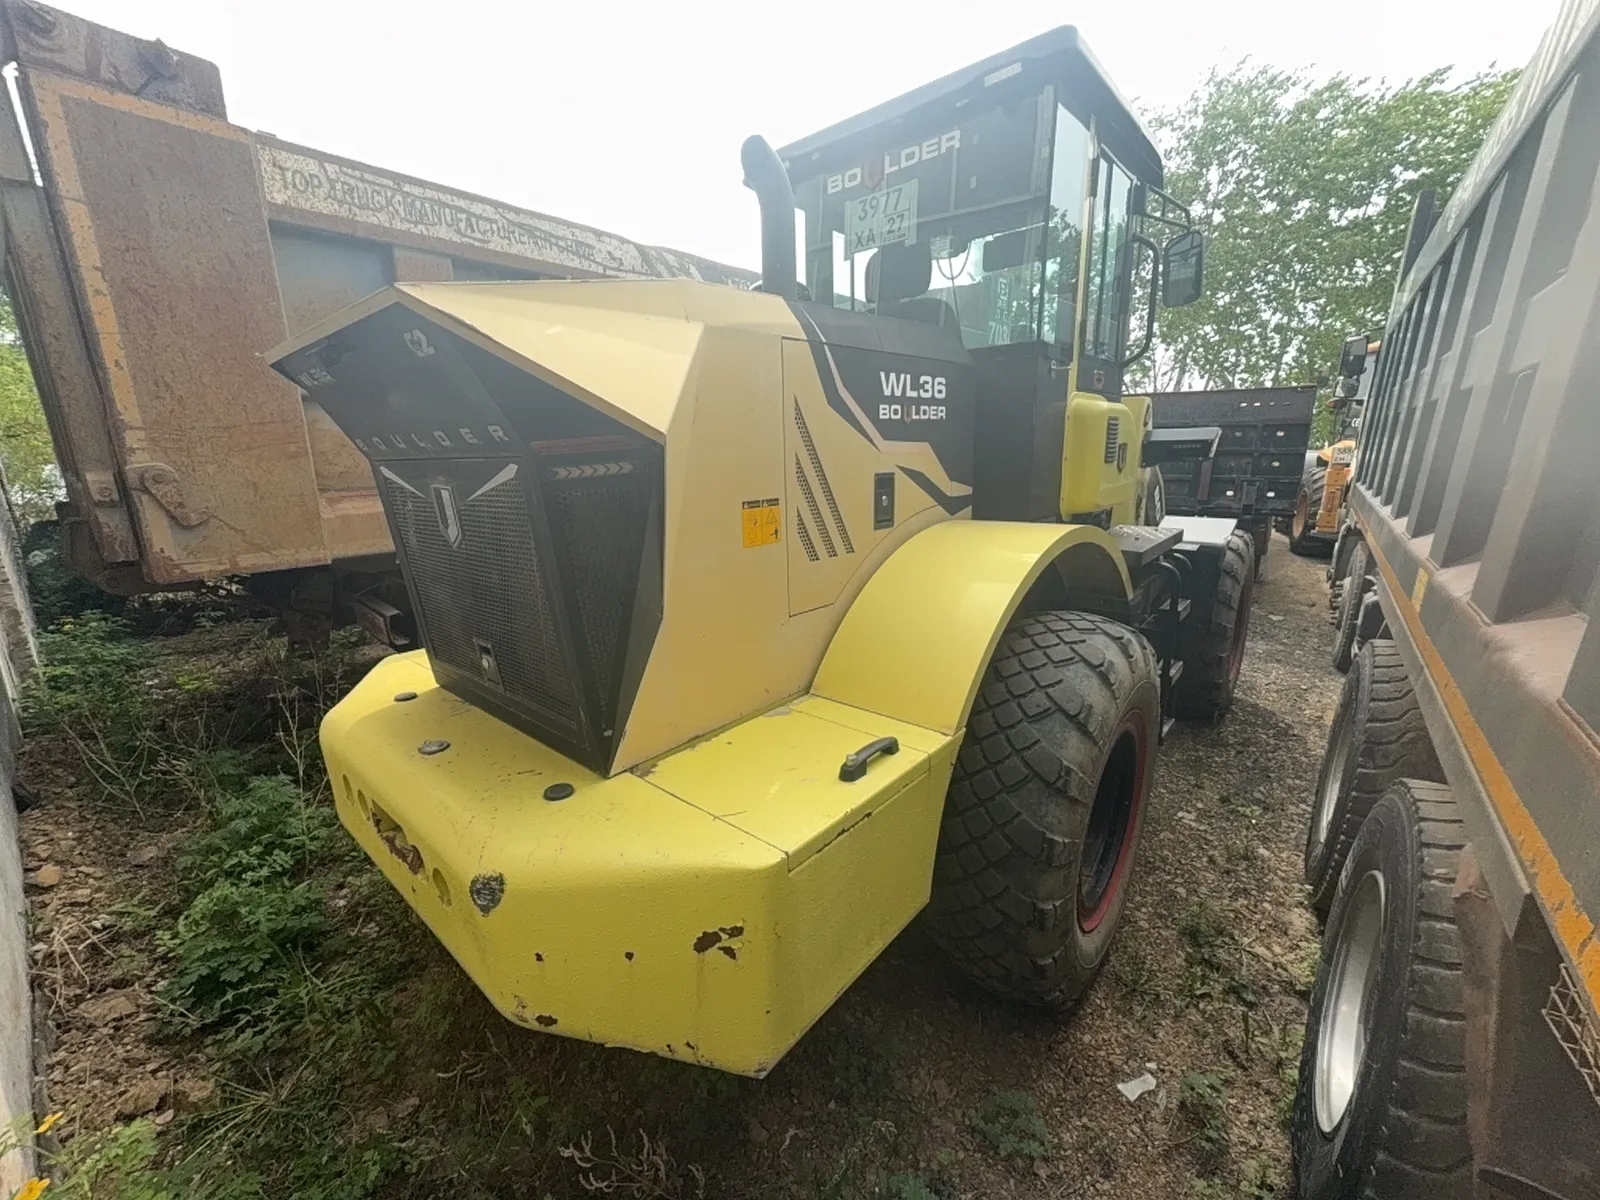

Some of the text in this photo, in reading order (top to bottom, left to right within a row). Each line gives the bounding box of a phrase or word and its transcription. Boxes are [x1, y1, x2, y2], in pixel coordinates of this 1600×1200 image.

[858, 187, 903, 221] 3977
[887, 213, 905, 235] 27
[879, 371, 946, 399] WL36
[354, 424, 510, 451] BOULDER
